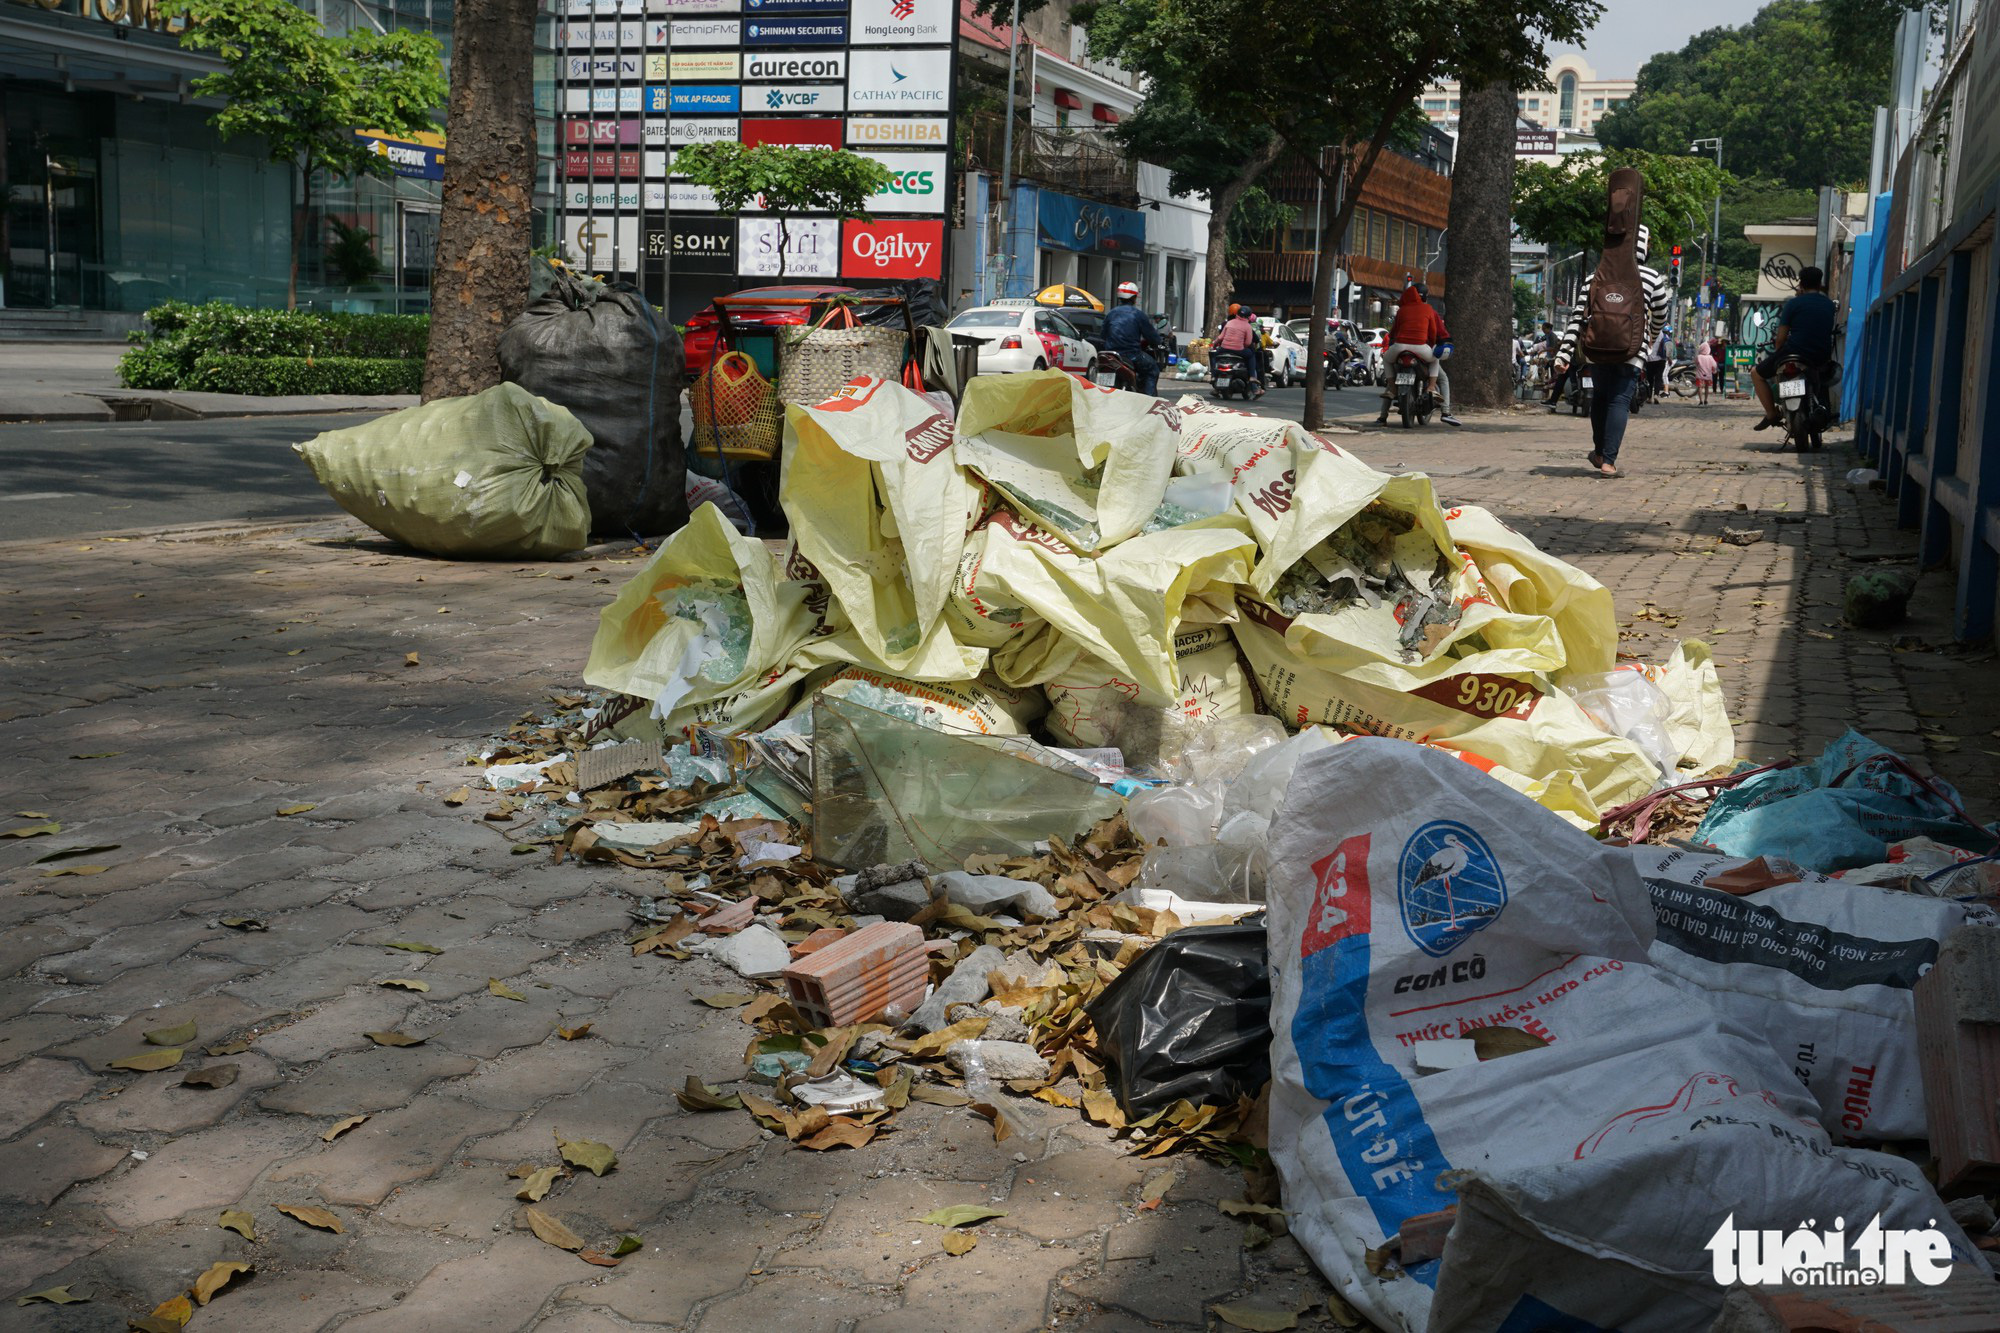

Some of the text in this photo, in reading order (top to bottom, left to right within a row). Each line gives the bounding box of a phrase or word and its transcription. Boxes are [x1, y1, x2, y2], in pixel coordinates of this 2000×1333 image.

[576, 30, 634, 40] NOVARIS
[671, 24, 738, 34] TechnipFMC
[798, 26, 842, 34] SECURITIES
[865, 24, 938, 36] HongLeong Bank
[750, 57, 838, 76] aurecon
[785, 93, 820, 104] VCBF
[854, 90, 944, 100] CATHAY PACIFIC
[671, 127, 682, 136] CHI
[699, 126, 736, 136] PARTNERS
[852, 124, 941, 140] TOSHIBA
[1516, 141, 1554, 150] An Na
[388, 146, 426, 166] GPBANK
[674, 234, 730, 250] SOHY
[853, 232, 932, 267] Ogilvy
[1184, 696, 1196, 708] ĐỎ
[1457, 675, 1534, 714] 9304
[1670, 888, 1694, 905] KHI
[1696, 896, 1738, 920] TRƯỚC
[1742, 910, 1776, 930] NGÀY
[1654, 902, 1826, 972] DÙNG CHO GÀ THỊT GIAI ĐOẠ
[1796, 928, 1825, 950] TUỔI
[1829, 944, 1866, 962] NGÀY
[1870, 950, 1888, 962] 22
[1394, 953, 1486, 994] CON CÒ
[1396, 1022, 1454, 1048] THỨC
[1488, 1000, 1536, 1027] HỖN
[1582, 959, 1624, 983] CHO
[1796, 1042, 1815, 1064] TỪ
[1840, 1064, 1876, 1132] THỨC
[1337, 1083, 1424, 1191] ÚT ĐẺ
